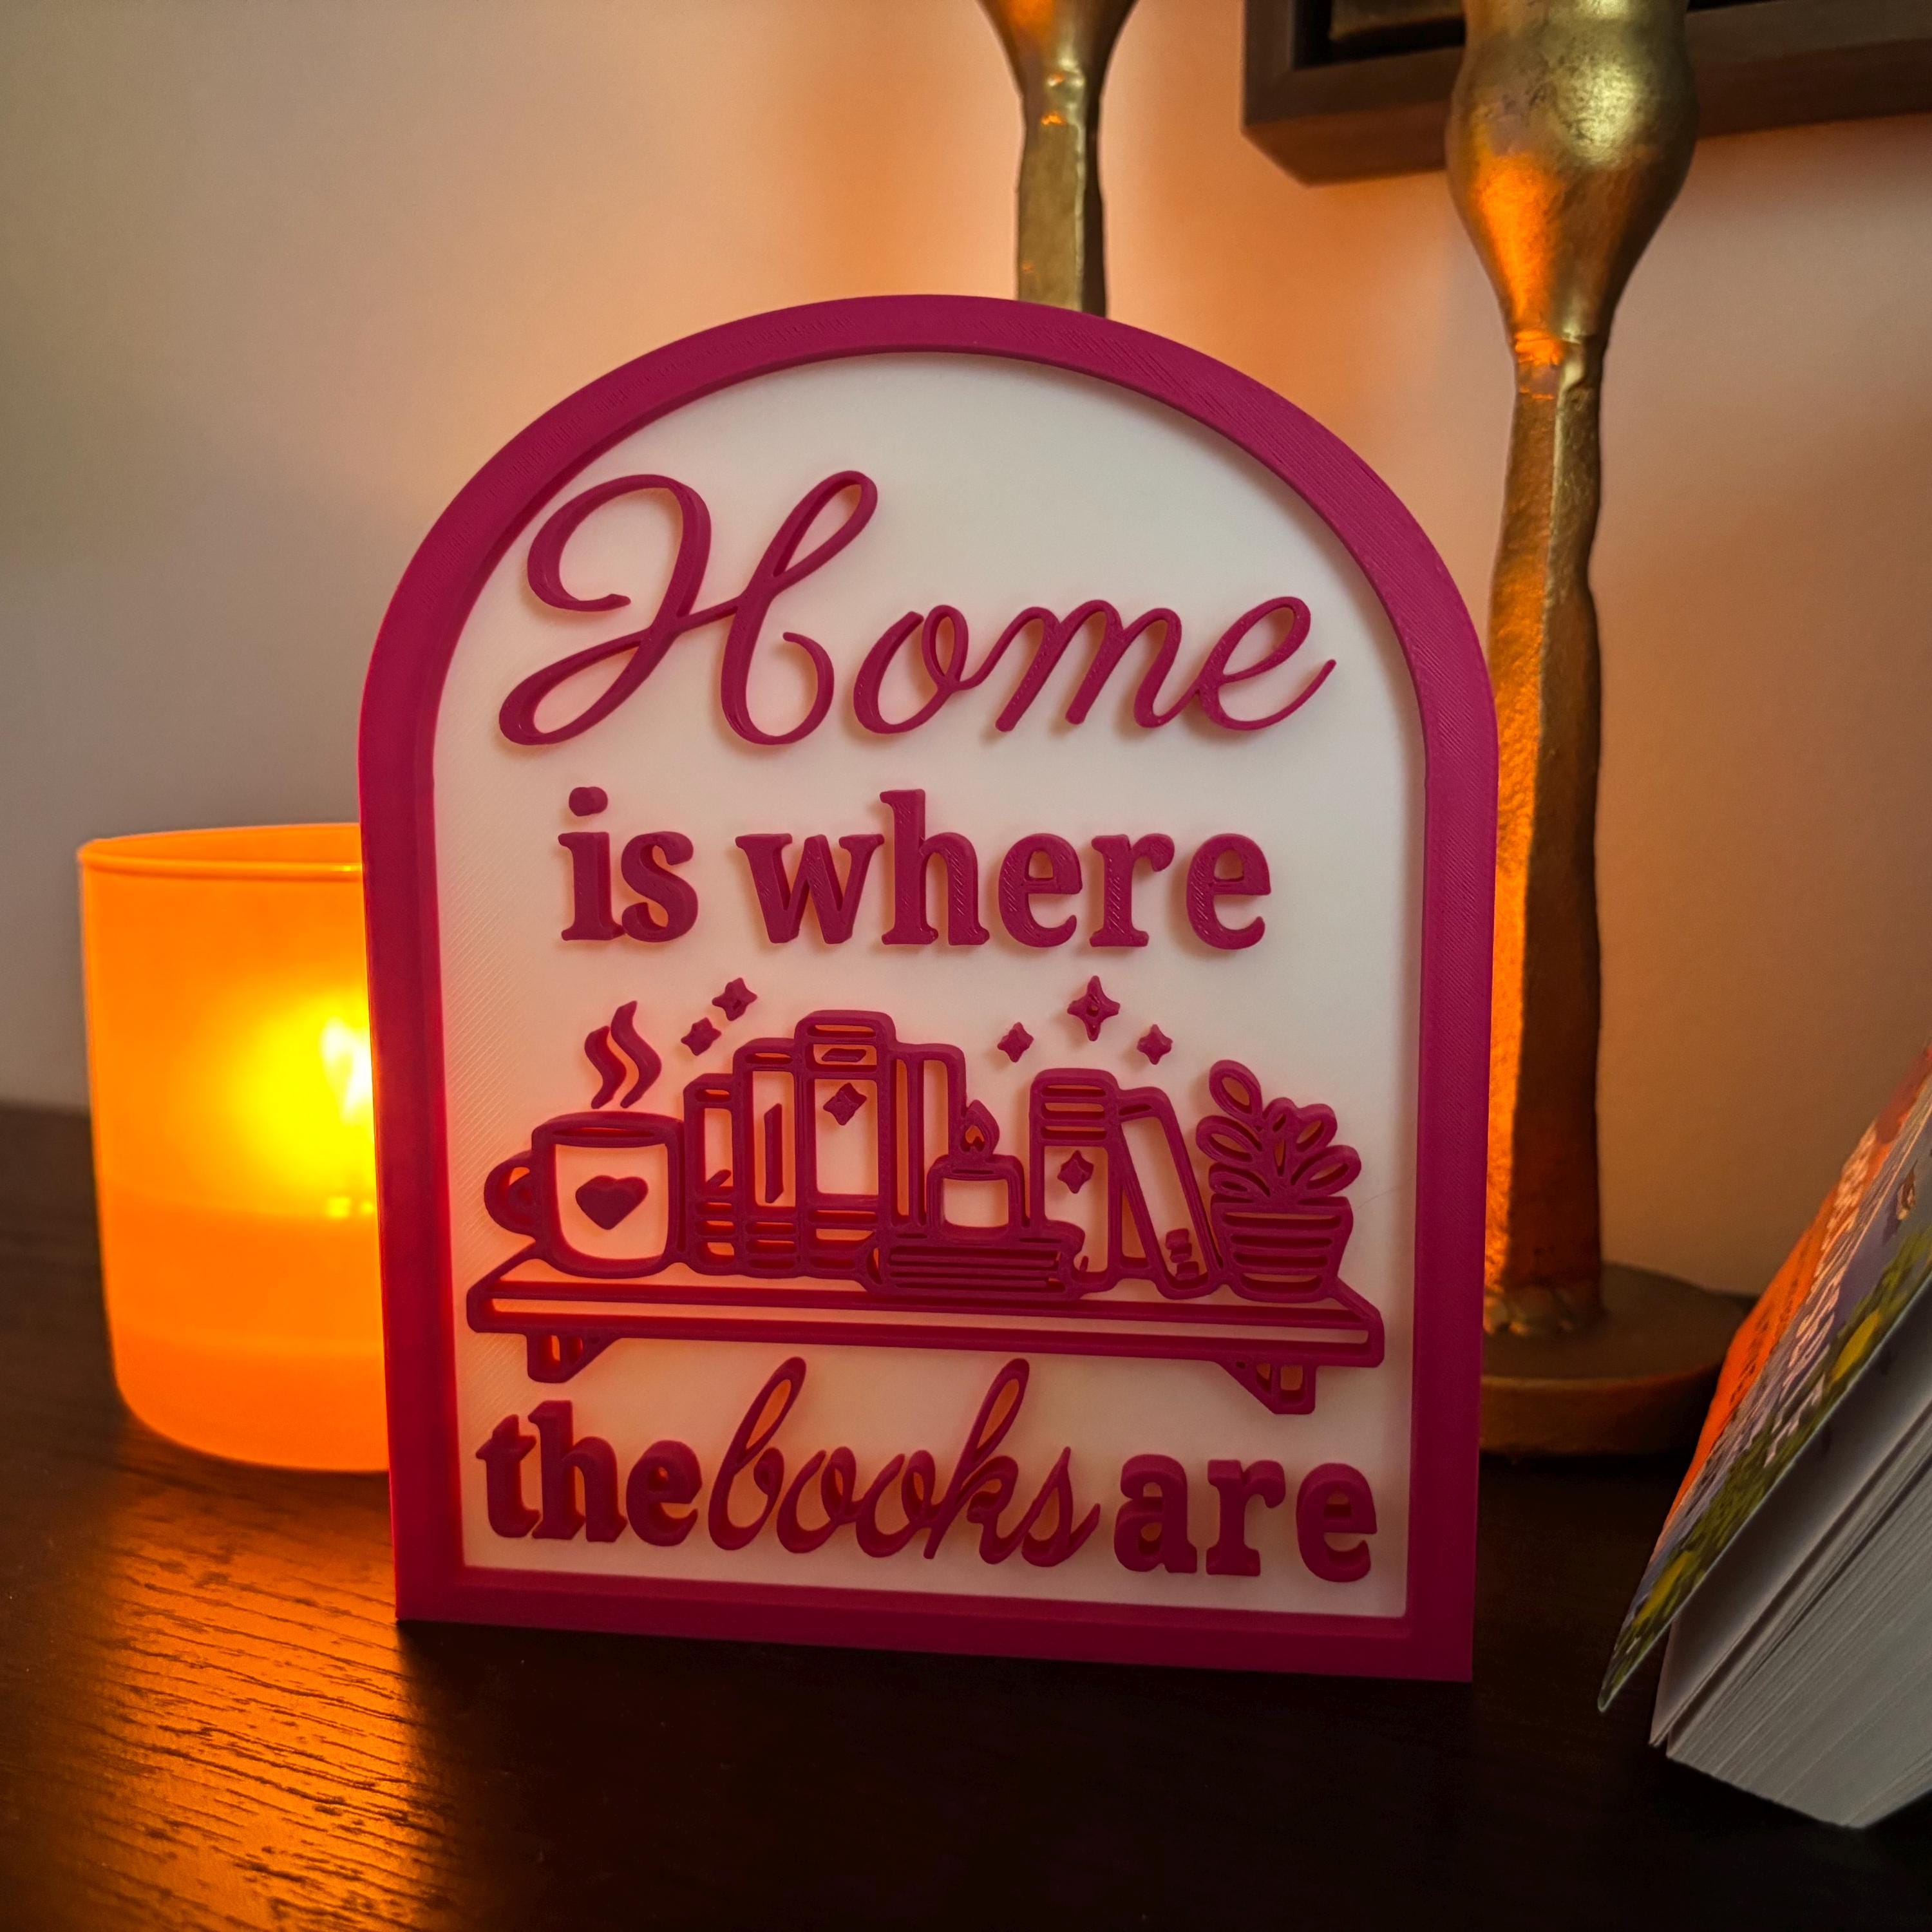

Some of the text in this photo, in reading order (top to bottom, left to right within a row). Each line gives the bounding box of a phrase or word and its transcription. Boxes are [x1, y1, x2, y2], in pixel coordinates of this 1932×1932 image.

[499, 470, 1336, 747] Home
[558, 787, 1271, 951] is where
[476, 1356, 1379, 1584] the books are
